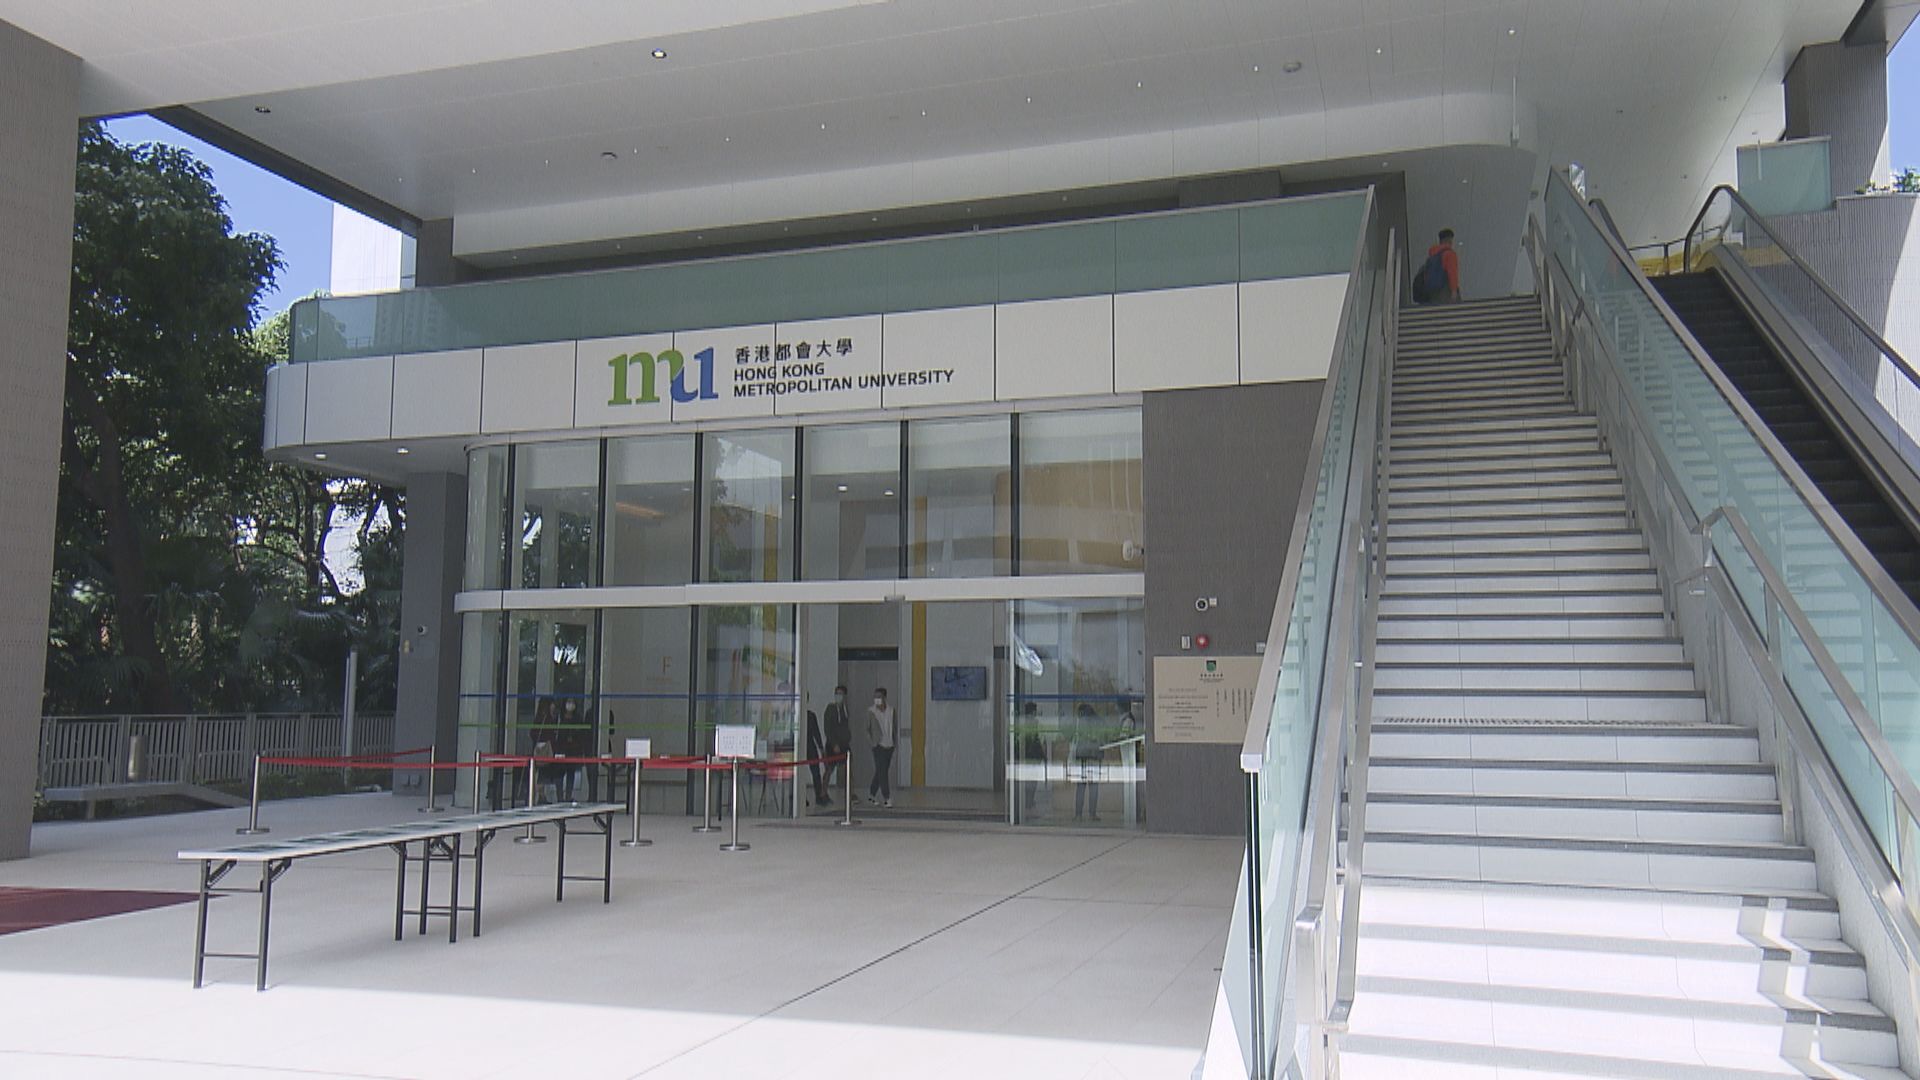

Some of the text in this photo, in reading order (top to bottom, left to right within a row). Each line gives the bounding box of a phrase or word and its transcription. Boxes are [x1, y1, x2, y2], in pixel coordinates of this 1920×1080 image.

[735, 338, 853, 364] 香港都會大學
[734, 362, 825, 382] HONG KONG
[734, 369, 954, 398] METROPOLITAN UNIVERSITY
